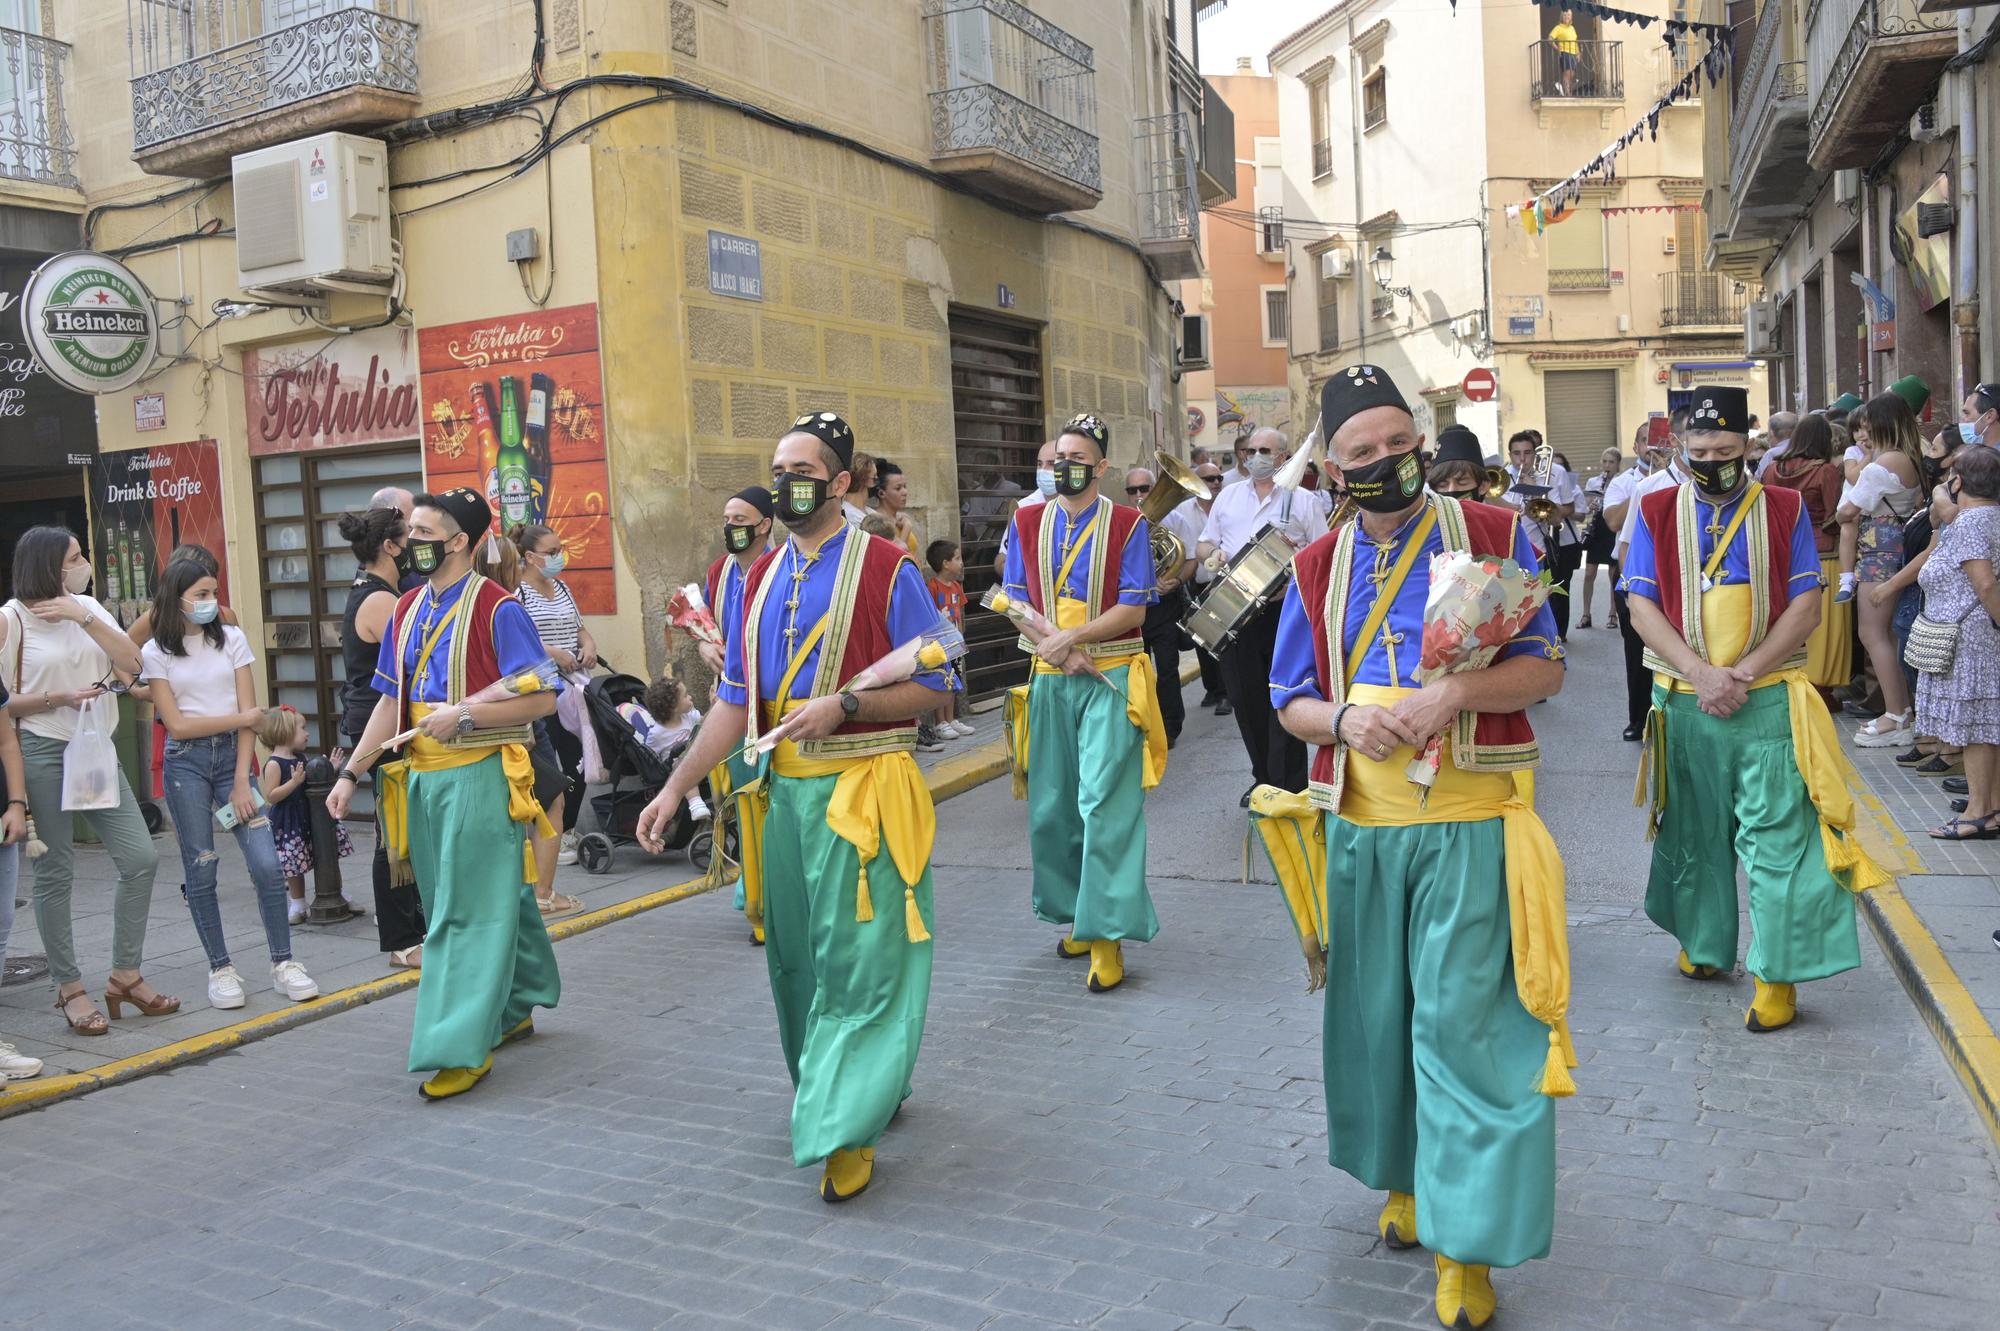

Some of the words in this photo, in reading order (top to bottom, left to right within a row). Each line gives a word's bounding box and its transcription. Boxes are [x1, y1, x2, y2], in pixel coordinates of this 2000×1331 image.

[721, 238, 757, 257] CARRER
[62, 273, 107, 297] HEINEKEN
[111, 278, 132, 299] BEER
[54, 312, 145, 332] Heineken
[467, 321, 546, 352] Tertulia
[65, 344, 107, 373] PREMIUM
[111, 345, 141, 373] QUALITY
[259, 354, 418, 442] Tertulia
[127, 452, 173, 472] Tertulia
[108, 482, 144, 503] Drink
[146, 479, 157, 499] &
[160, 476, 202, 502] Coffee
[501, 493, 531, 504] Heineken
